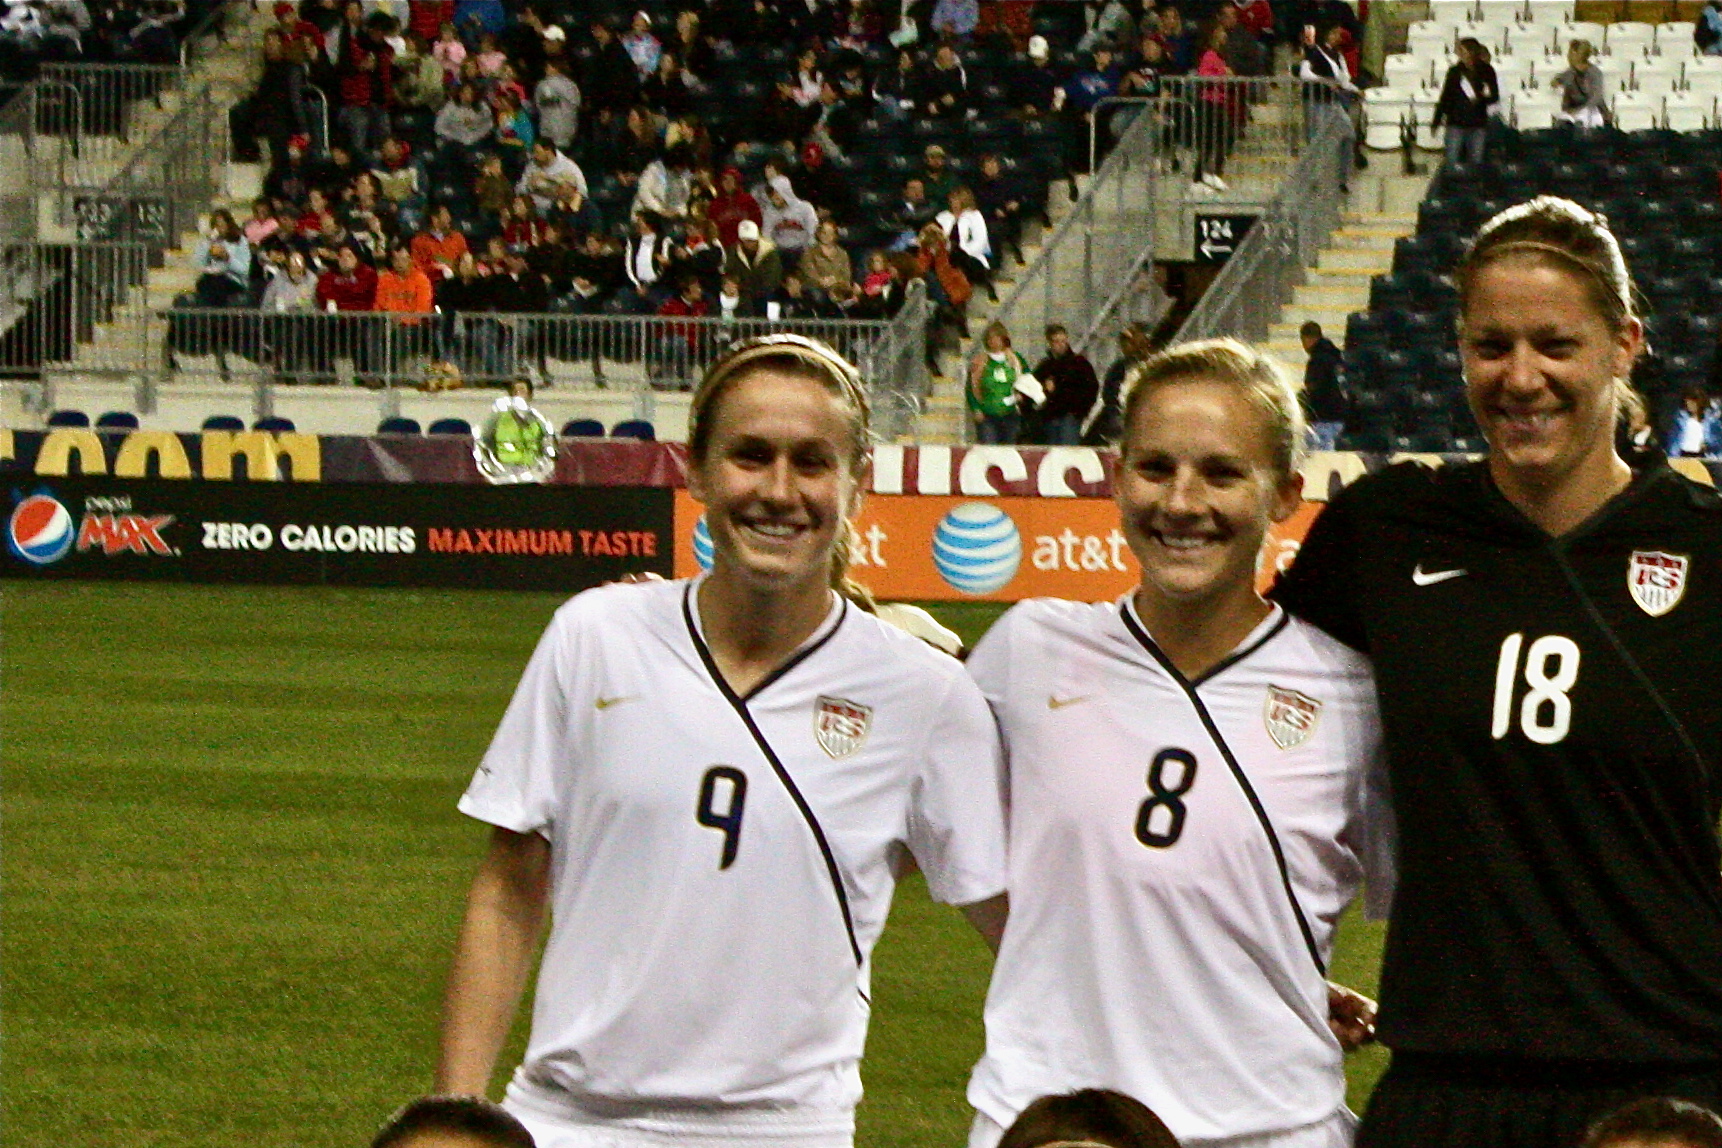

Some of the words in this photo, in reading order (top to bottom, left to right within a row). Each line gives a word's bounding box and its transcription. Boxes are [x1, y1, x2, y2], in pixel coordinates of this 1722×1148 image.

[1199, 218, 1234, 240] 124
[76, 512, 177, 557] MAX
[201, 521, 273, 552] ZERO
[280, 524, 417, 554] CALORIES
[428, 526, 573, 556] MAXIMUM
[581, 529, 656, 559] TASTE
[1032, 527, 1128, 571] at&t
[1491, 632, 1580, 744] 18
[696, 765, 747, 870] 9
[1134, 748, 1197, 850] 8
